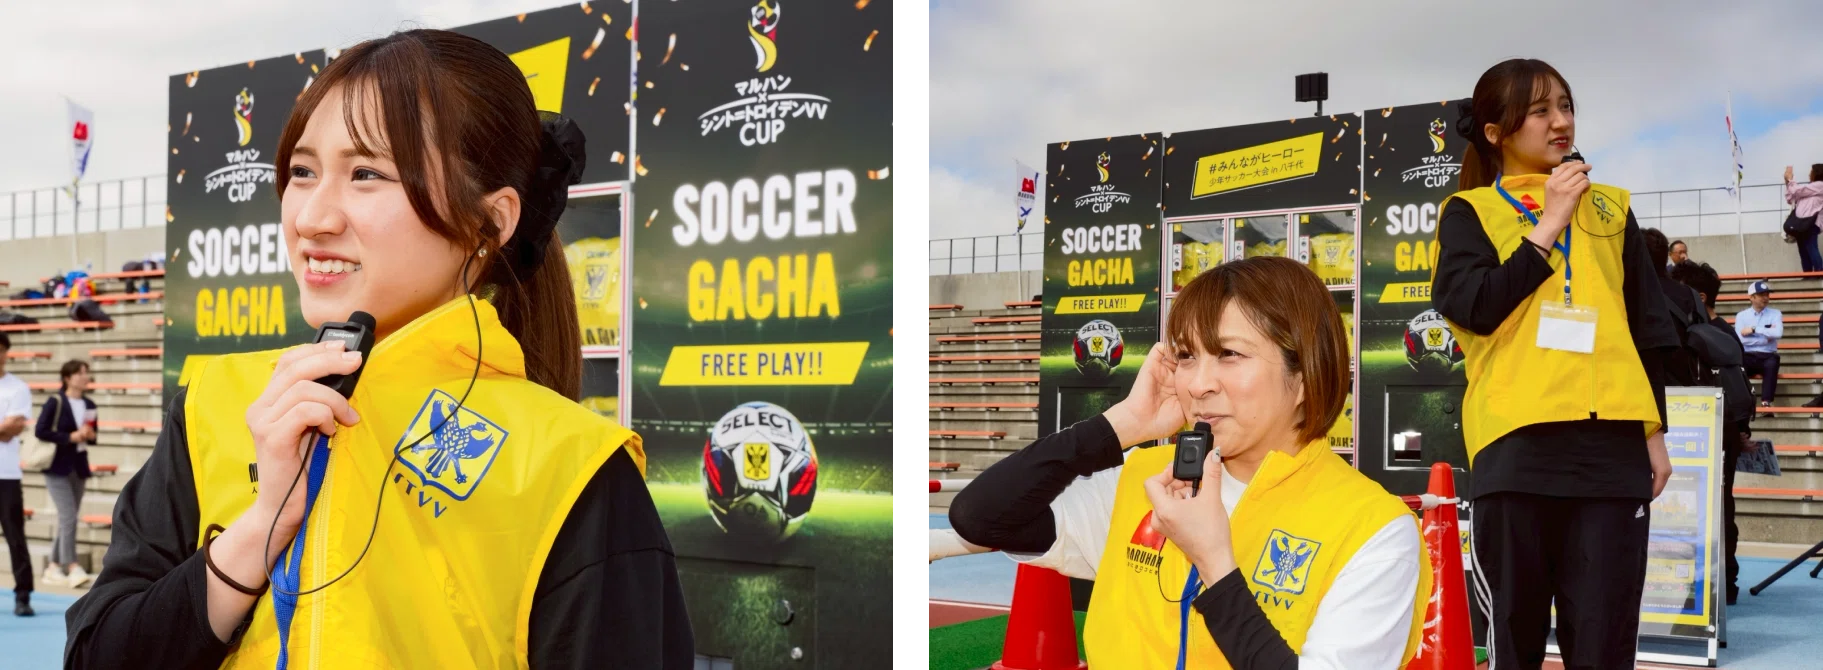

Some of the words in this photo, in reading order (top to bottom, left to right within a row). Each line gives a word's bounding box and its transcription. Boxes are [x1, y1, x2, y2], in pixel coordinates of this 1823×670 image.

[735, 74, 792, 96] マルハン
[739, 119, 786, 147] CUP
[1208, 148, 1305, 175] #みんながヒーロー
[1421, 154, 1454, 165] マルハン
[227, 182, 257, 203] CUP
[1424, 174, 1451, 188] CUP
[671, 168, 858, 248] SOCCER
[1091, 202, 1113, 214] CUP
[1385, 202, 1441, 236] SOC
[1061, 223, 1143, 255] SOCCER
[1067, 256, 1135, 287] GACHA
[688, 252, 841, 322] GACHA
[1403, 285, 1431, 298] FREE
[195, 284, 287, 337] GACHA
[1073, 299, 1095, 310] FREE
[1098, 298, 1127, 309] PLAY!!
[1081, 323, 1114, 335] SELECT
[1414, 312, 1444, 326] SELE
[701, 353, 748, 377] FREE
[757, 351, 824, 376] PLAY!!
[1666, 402, 1711, 412] ースクール
[721, 411, 794, 436] SELECT
